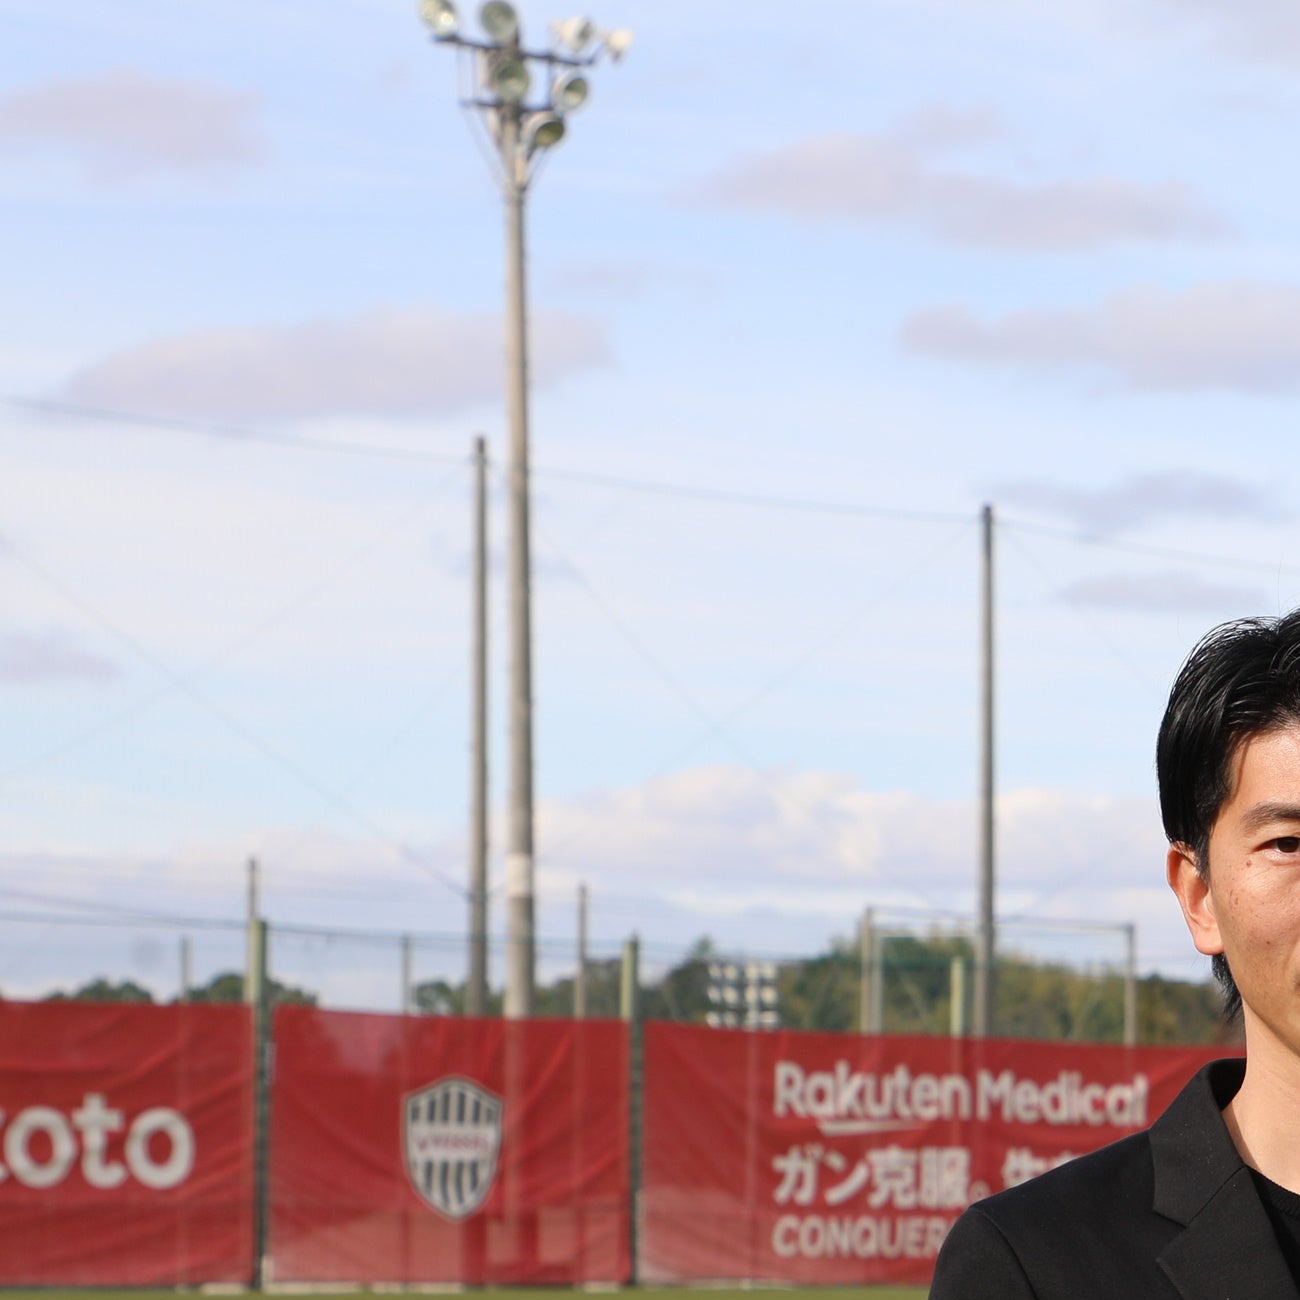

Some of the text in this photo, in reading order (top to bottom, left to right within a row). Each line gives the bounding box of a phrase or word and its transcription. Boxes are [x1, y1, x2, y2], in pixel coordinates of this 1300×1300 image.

[774, 1059, 1149, 1127] Rakuten Medical
[0, 1092, 195, 1189] oto
[772, 1215, 953, 1259] CONQUER
